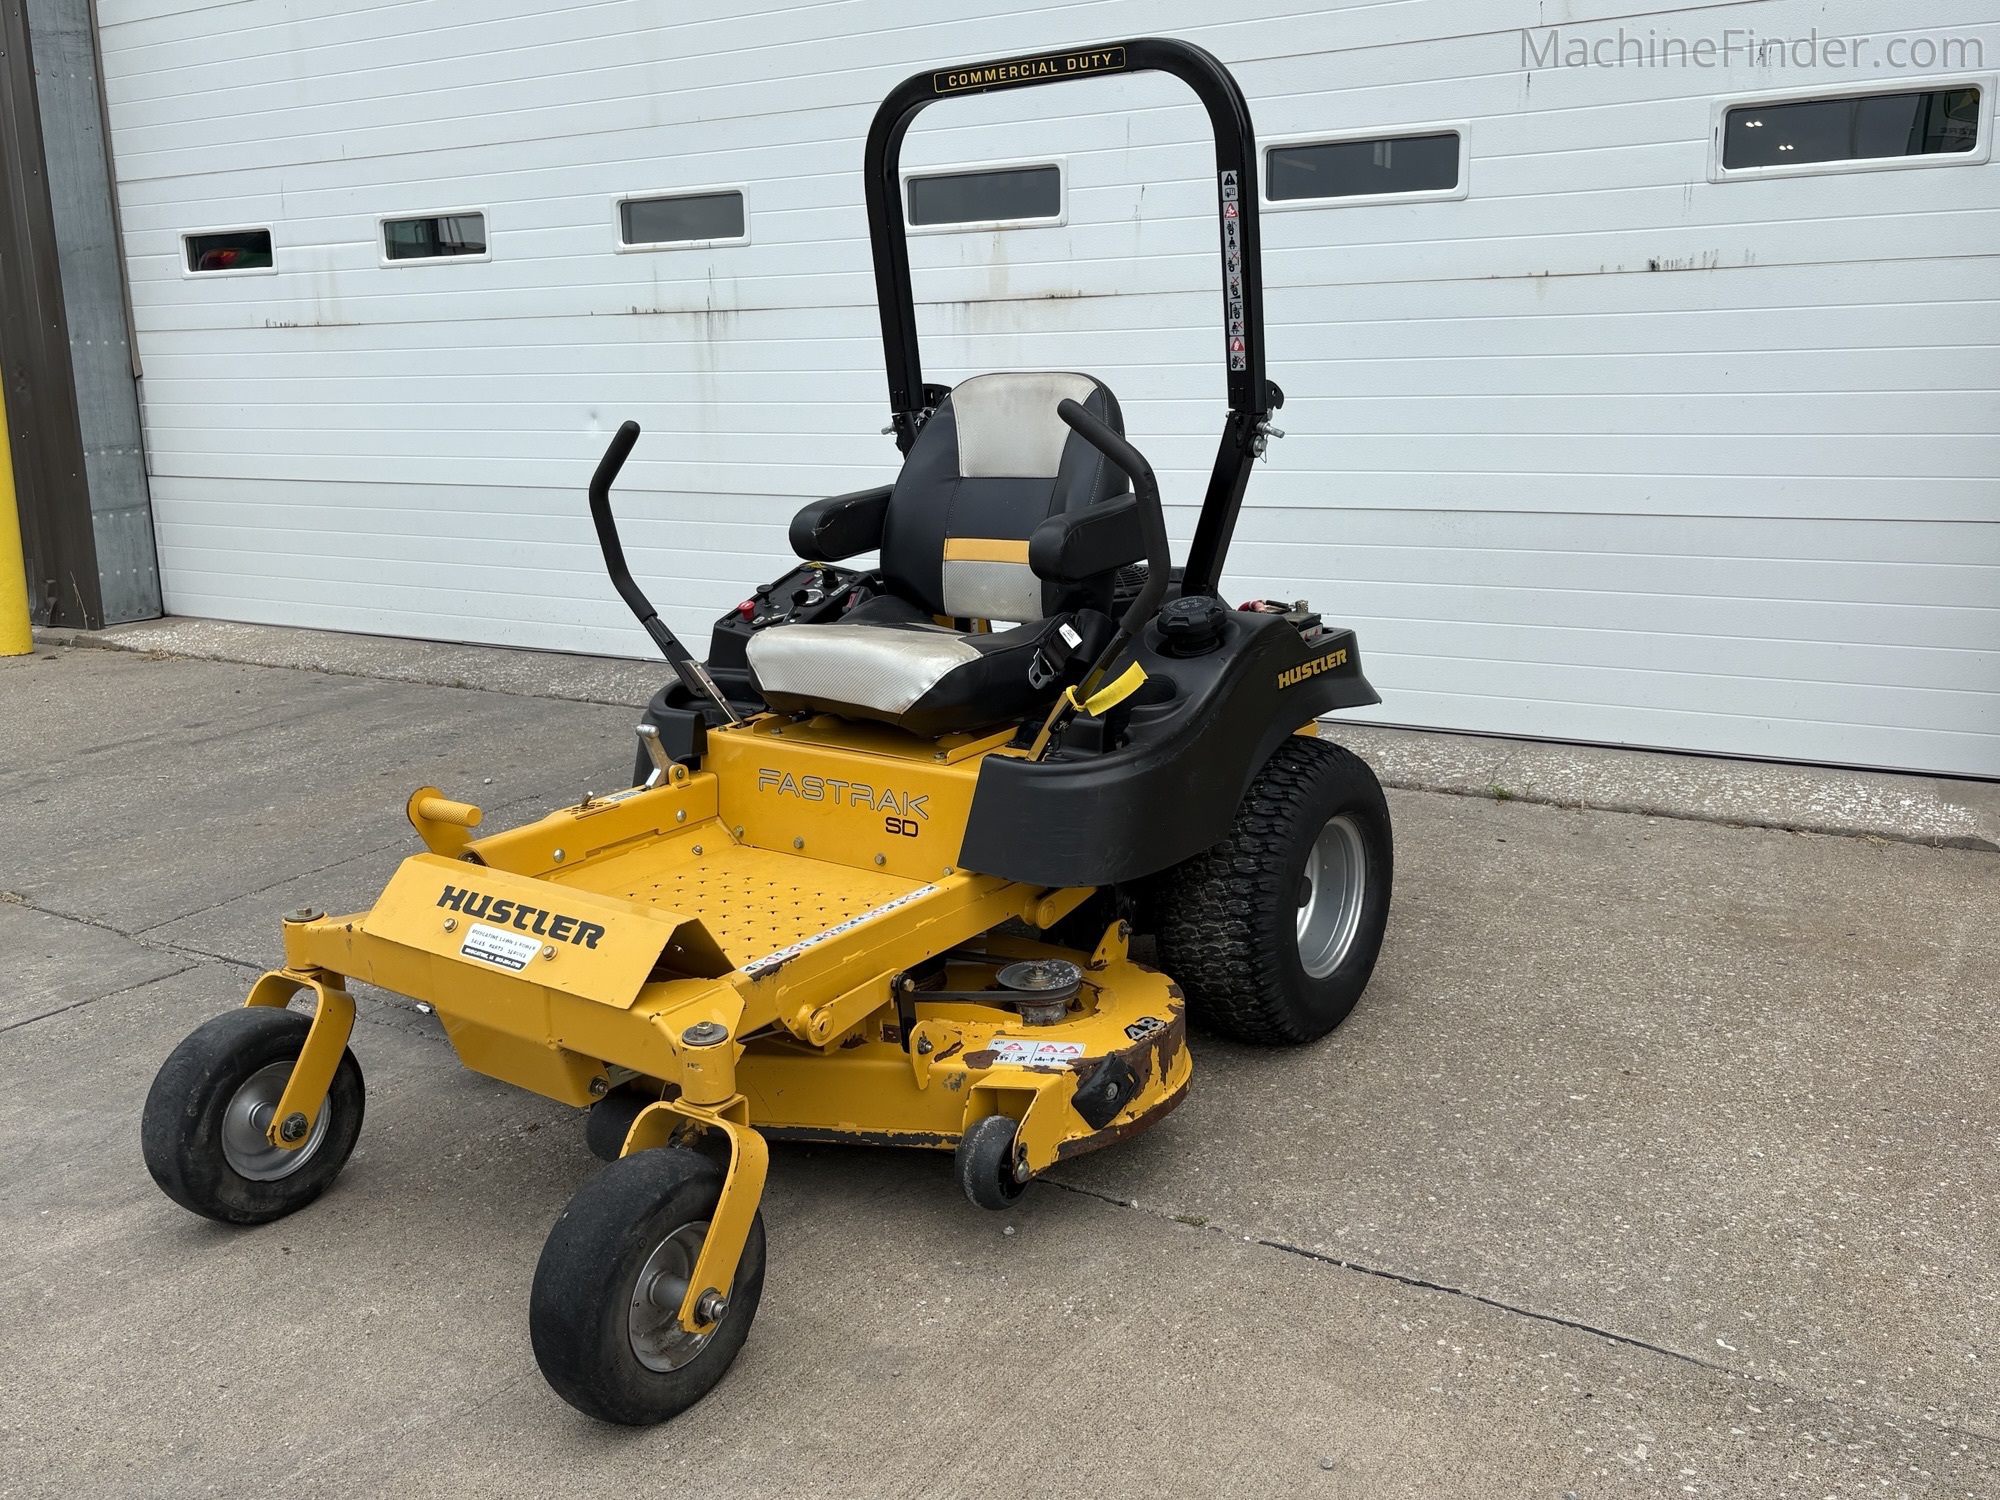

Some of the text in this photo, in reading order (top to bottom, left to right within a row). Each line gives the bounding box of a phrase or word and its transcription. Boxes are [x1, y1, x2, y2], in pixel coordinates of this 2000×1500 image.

[948, 53, 1112, 87] COMMERCIAL DUTY
[1278, 648, 1347, 689] HUSTLER
[759, 768, 929, 820] FASTRAK
[885, 816, 919, 838] SD
[436, 885, 605, 949] HUSTLER
